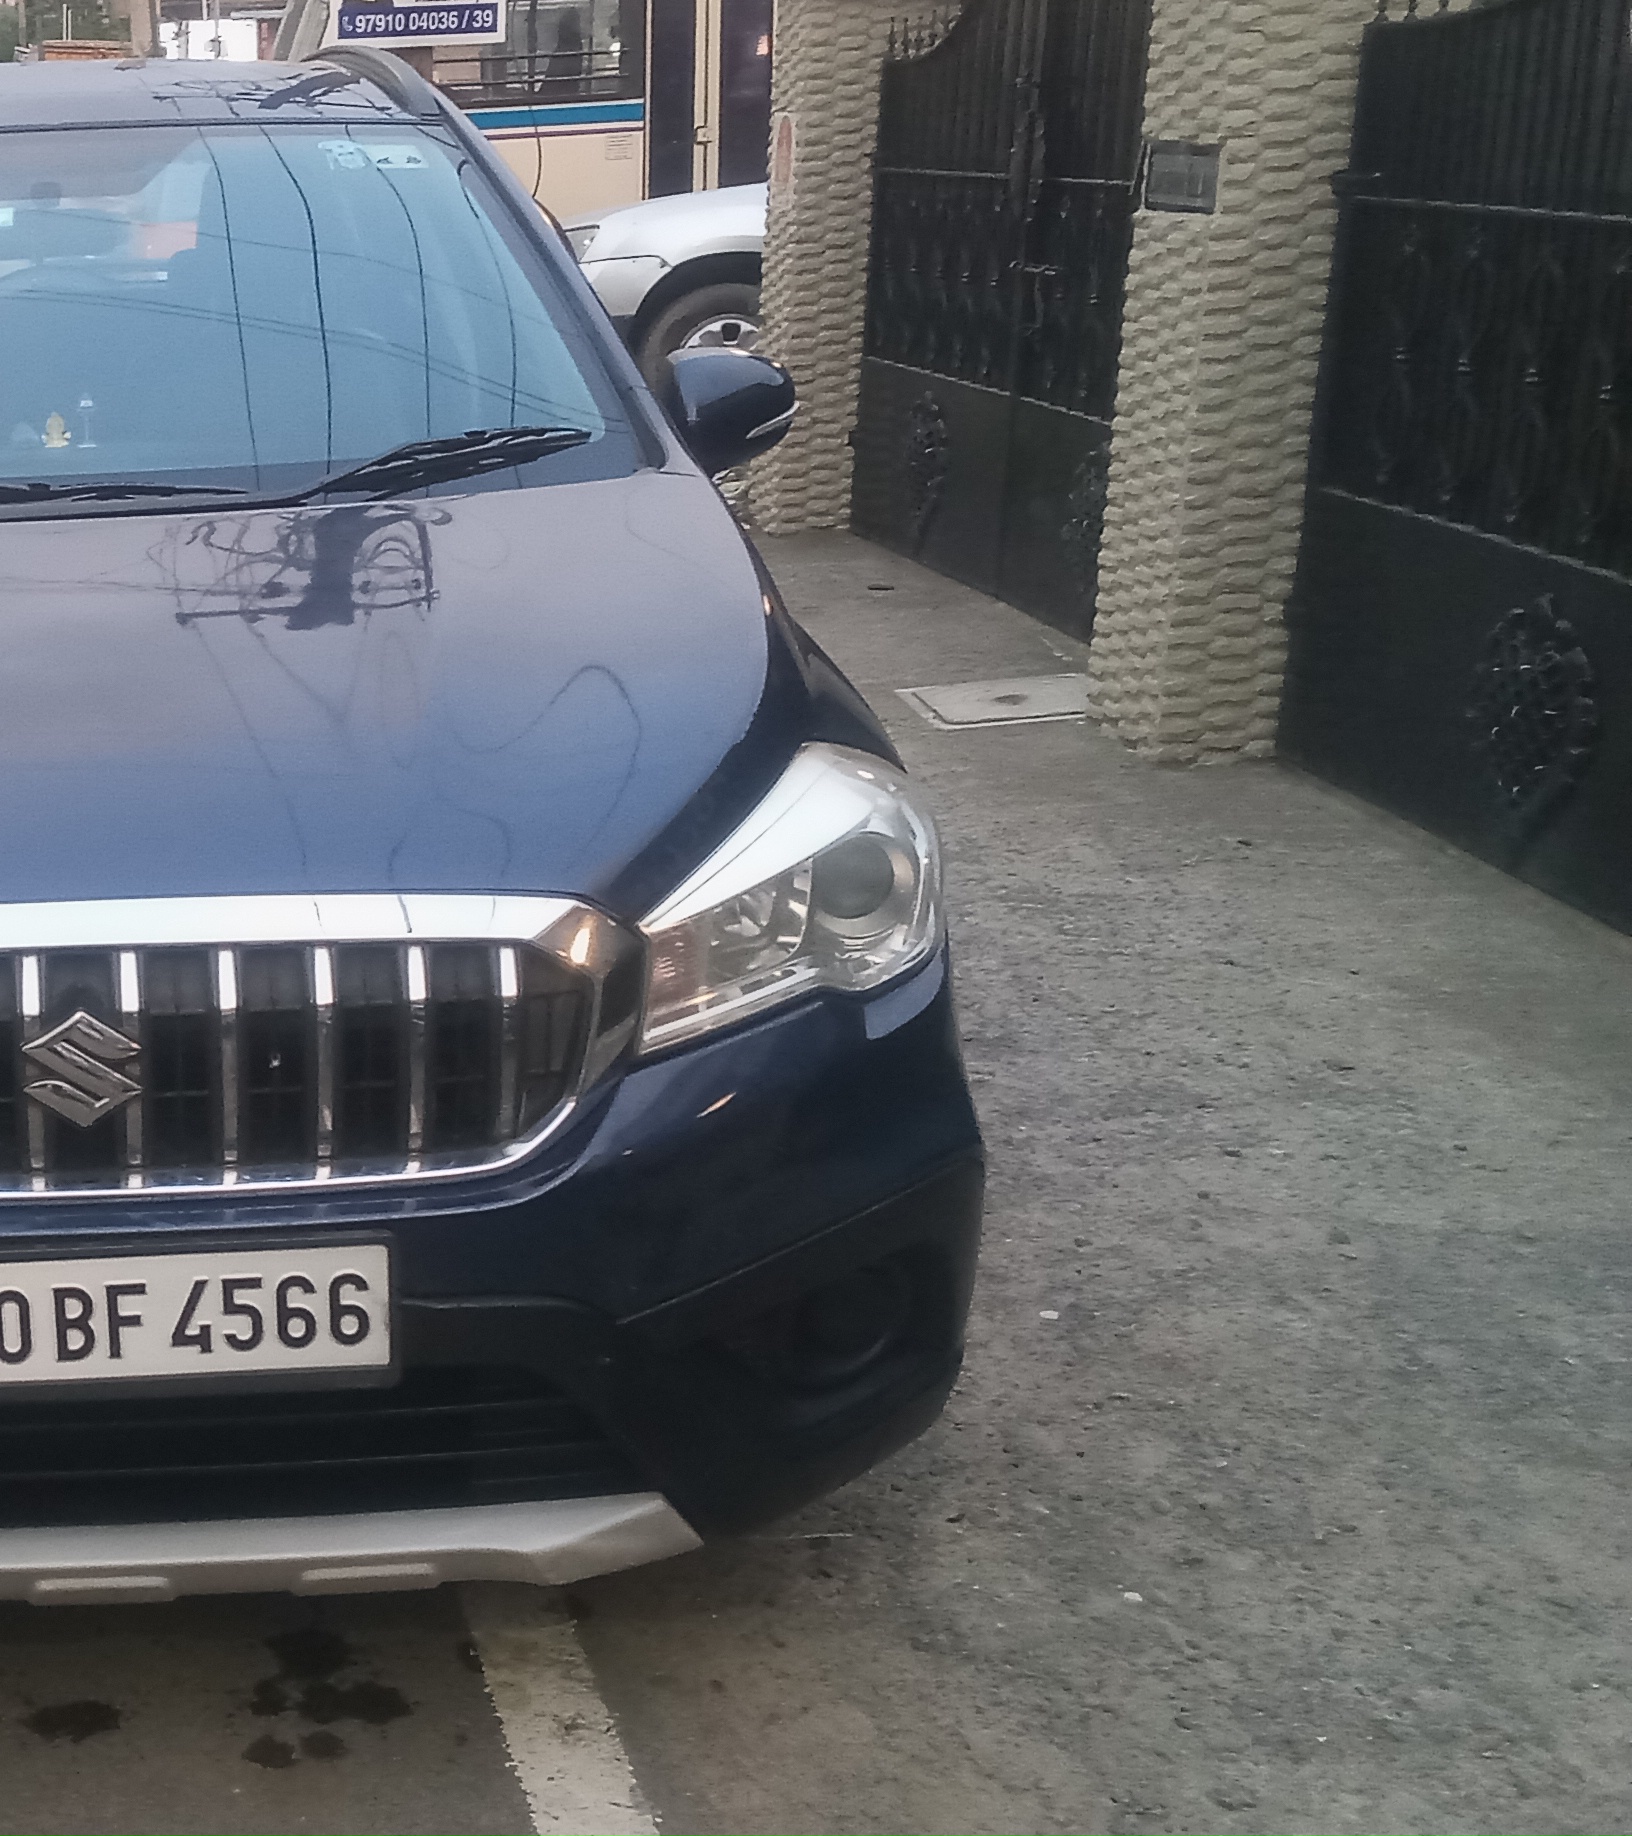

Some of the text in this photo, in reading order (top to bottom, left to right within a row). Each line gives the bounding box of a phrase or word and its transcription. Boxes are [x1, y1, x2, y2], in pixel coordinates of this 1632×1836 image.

[355, 14, 405, 33] 97910
[409, 11, 458, 30] 04036
[472, 9, 493, 28] 39
[53, 1281, 147, 1362] BF
[171, 1272, 370, 1353] 4566
